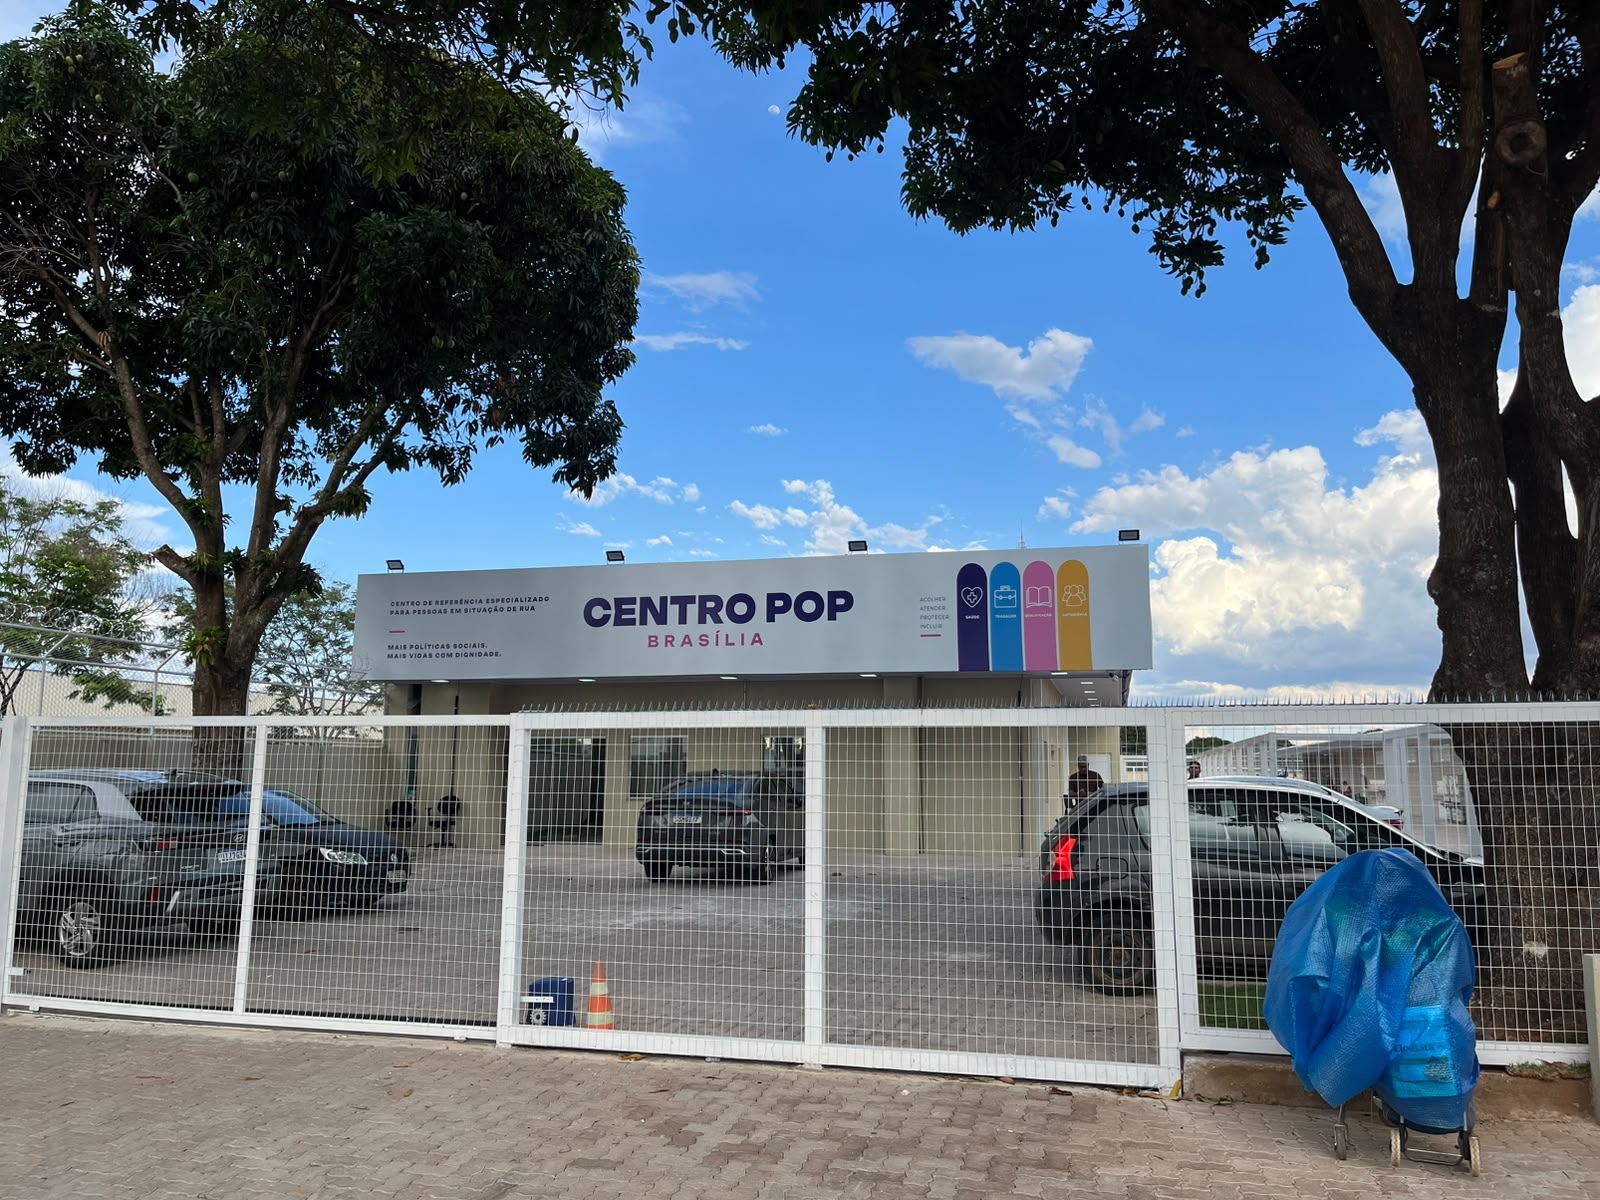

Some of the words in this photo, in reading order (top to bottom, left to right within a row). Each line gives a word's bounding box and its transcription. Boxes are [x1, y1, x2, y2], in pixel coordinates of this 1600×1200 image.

[434, 598, 483, 606] REFERÊNCIA
[485, 596, 550, 604] ESPECIALIZADO
[464, 606, 504, 614] SITUAÇÃO
[583, 594, 756, 628] CENTRO
[766, 589, 854, 623] POP
[647, 630, 764, 648] BRASÍLIA
